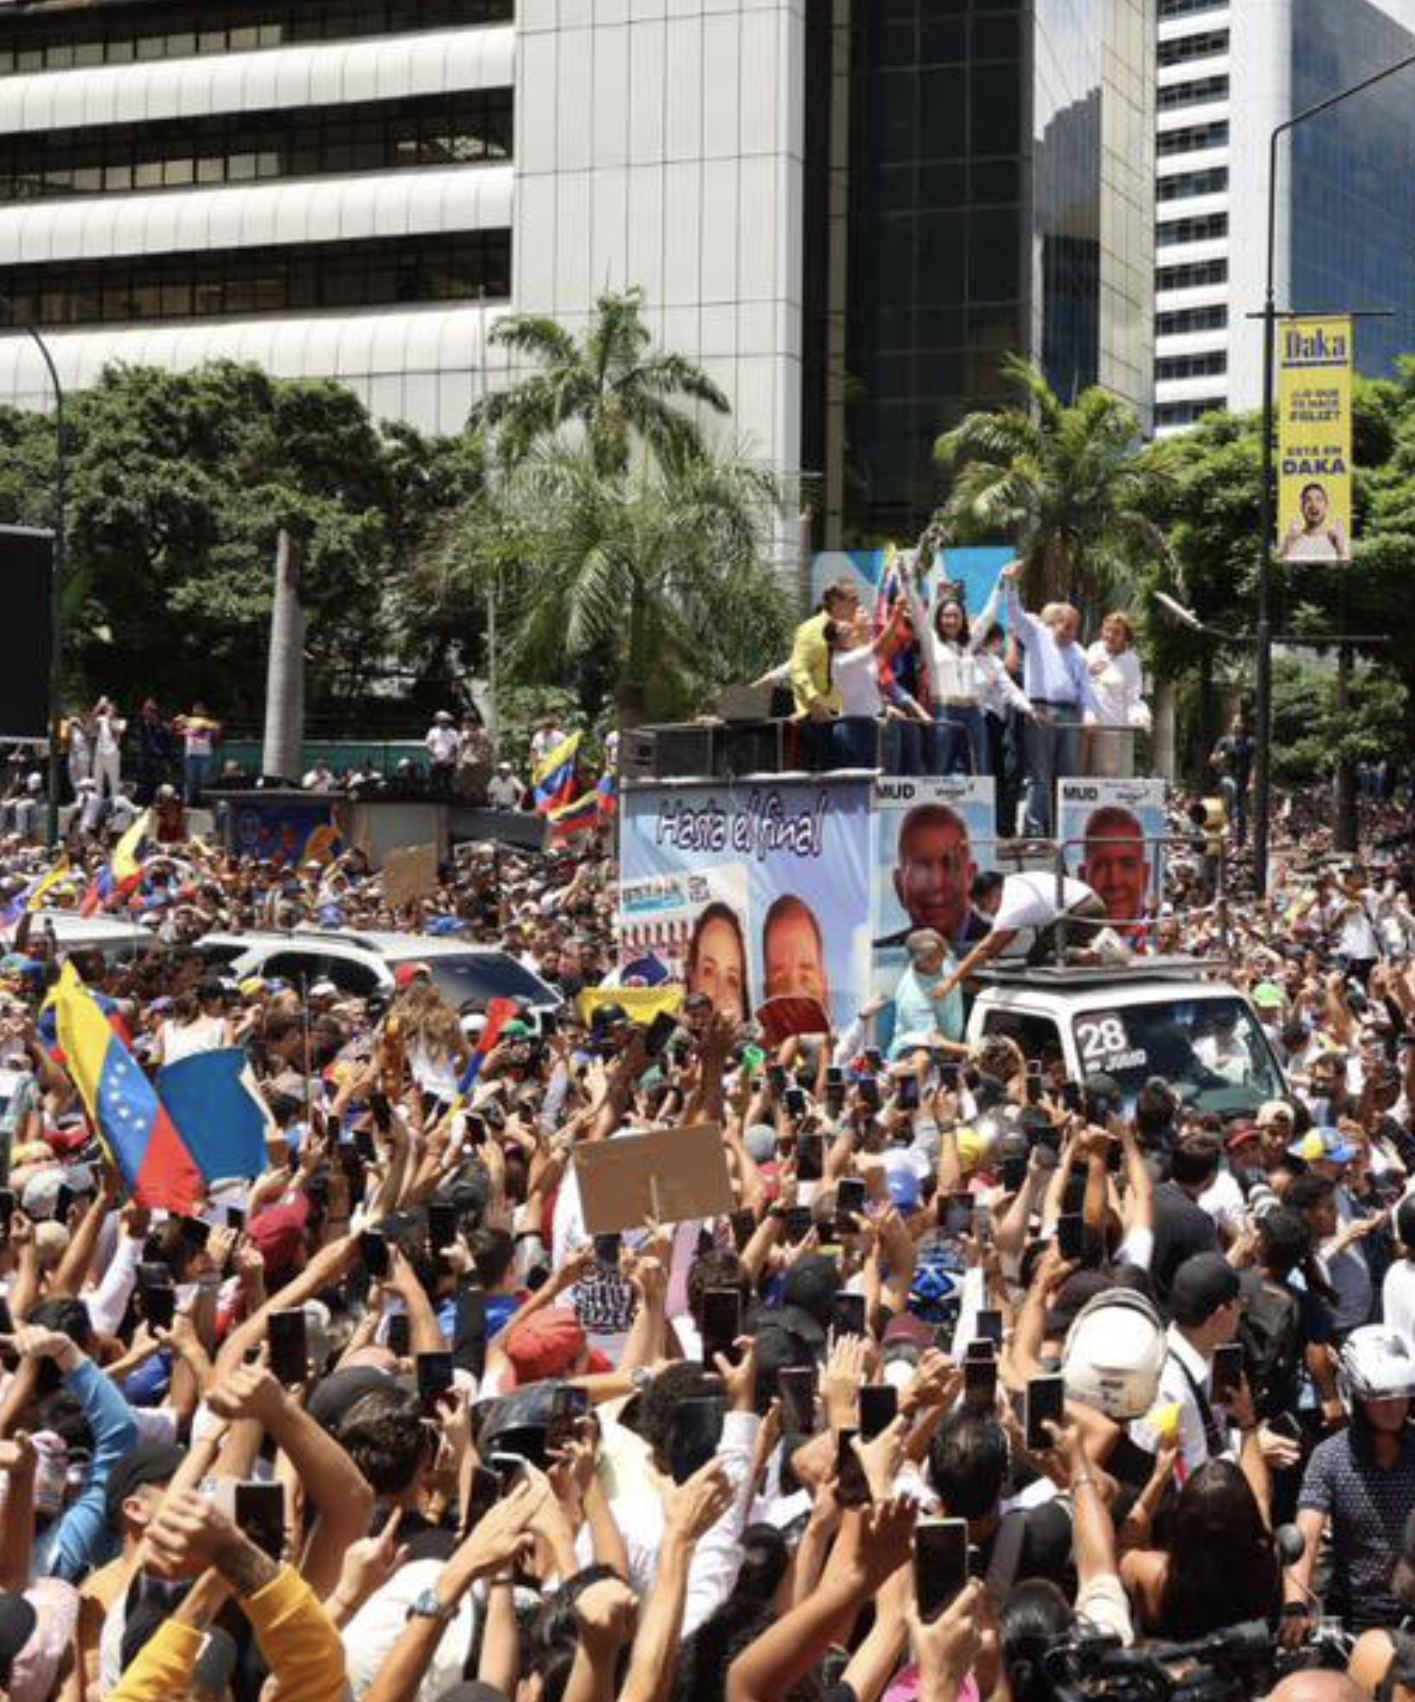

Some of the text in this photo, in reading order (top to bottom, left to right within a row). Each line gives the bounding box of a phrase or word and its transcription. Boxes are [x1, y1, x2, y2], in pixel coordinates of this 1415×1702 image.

[1286, 328, 1345, 358] Daka
[1282, 459, 1345, 473] DAKA
[875, 784, 915, 799] MUD
[1063, 786, 1098, 800] MUD
[656, 789, 829, 862] Hasta el final
[1077, 1019, 1127, 1058] 28
